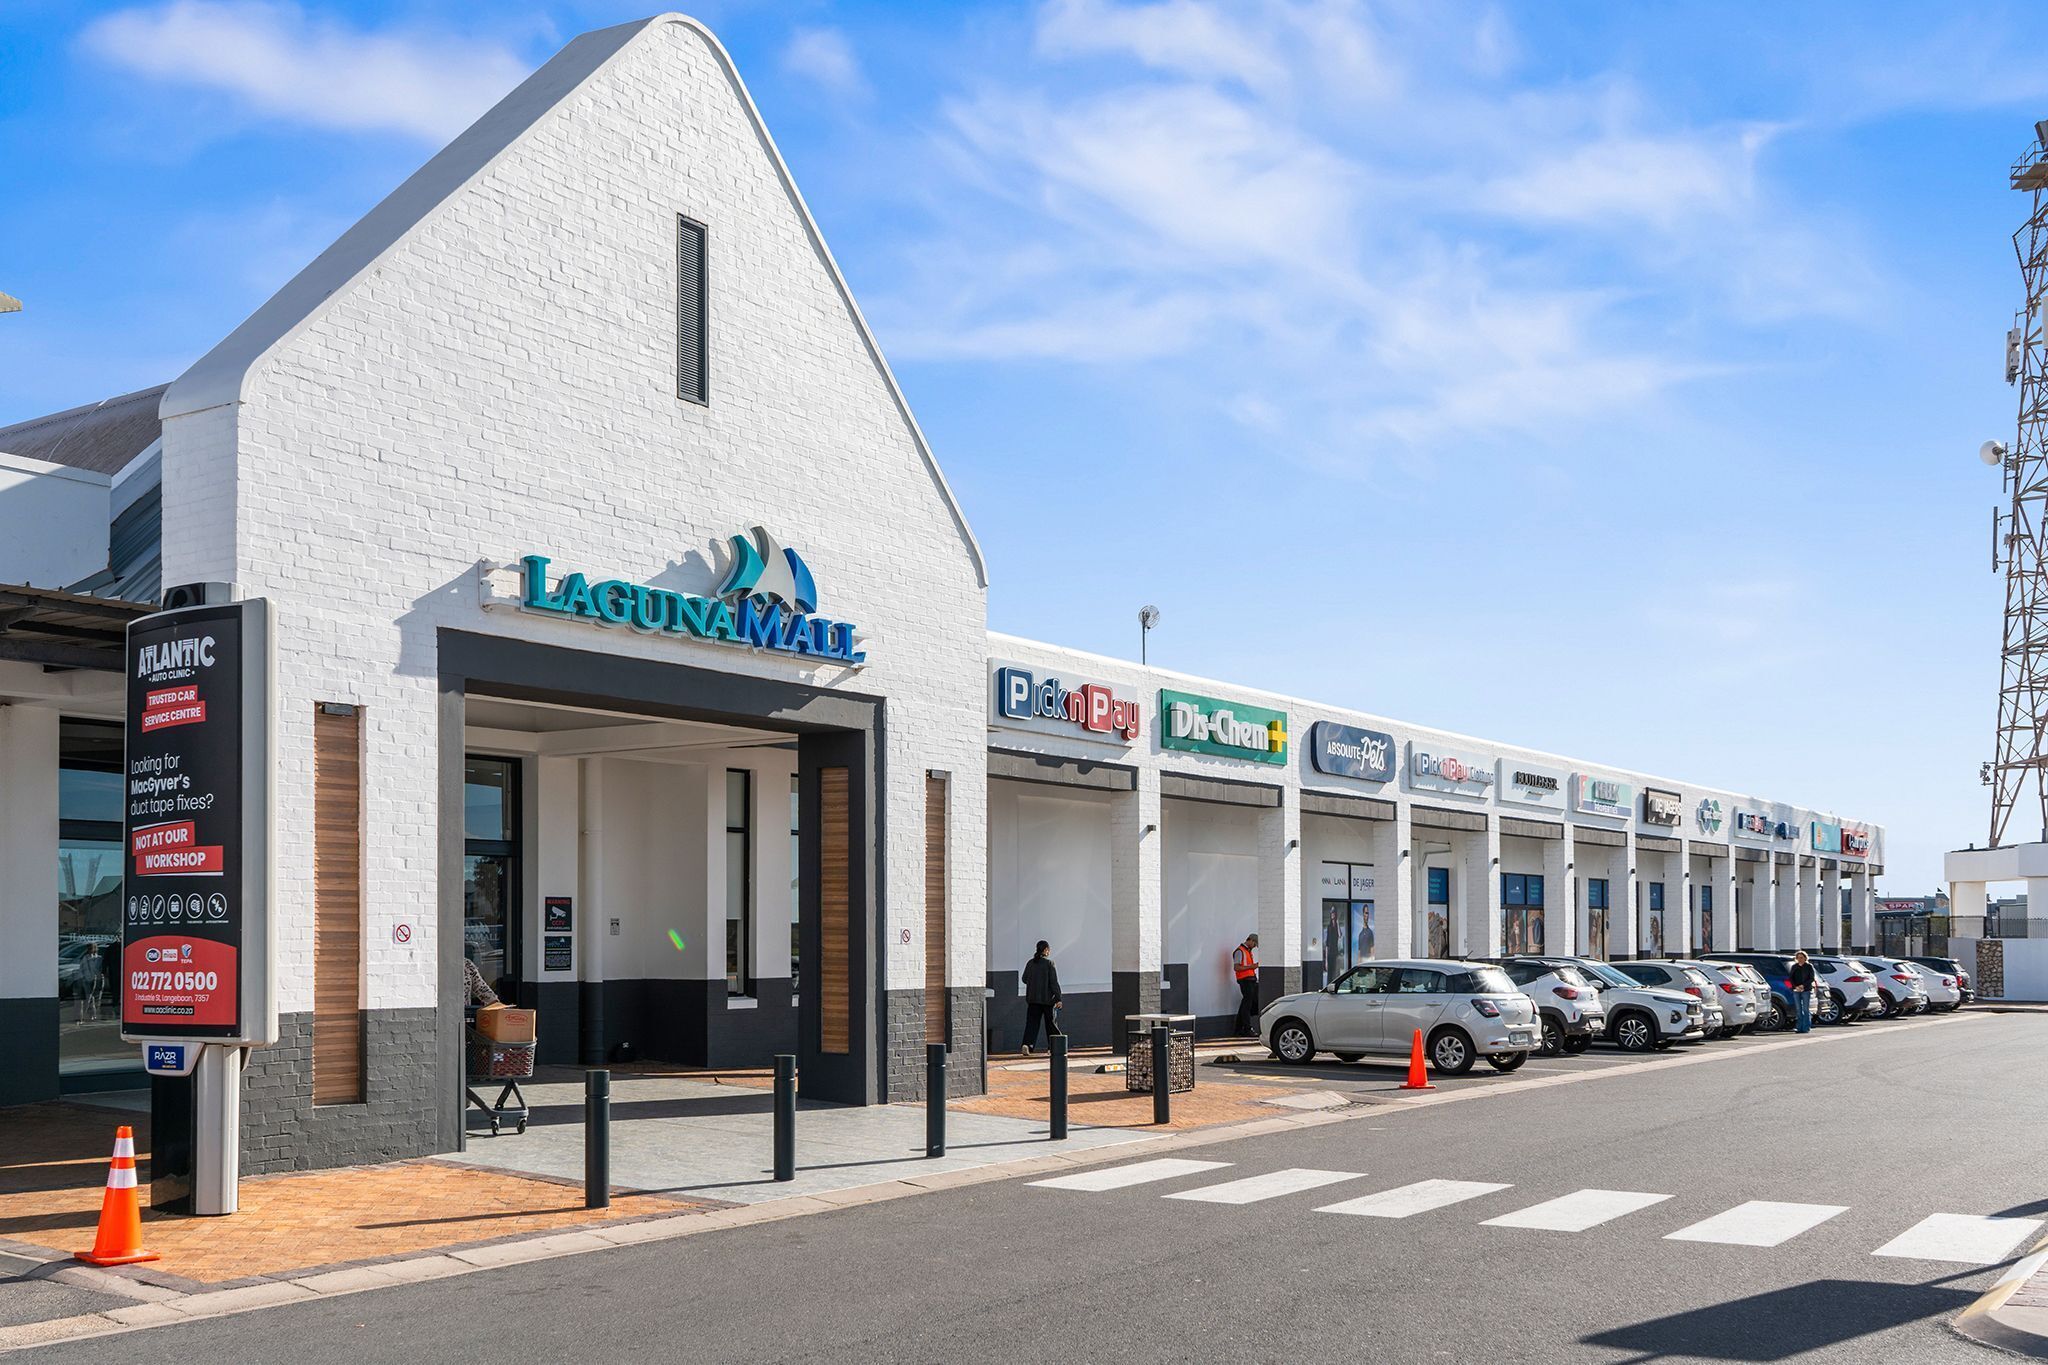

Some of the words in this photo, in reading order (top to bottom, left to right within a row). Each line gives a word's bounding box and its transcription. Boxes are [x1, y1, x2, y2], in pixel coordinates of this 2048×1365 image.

[138, 636, 216, 678] ATLANTIC
[152, 671, 167, 682] AUTO
[168, 668, 191, 680] CLINIC
[149, 692, 176, 706] TRUSTED
[177, 690, 195, 701] CAR
[1003, 666, 1068, 720] Pick
[1069, 691, 1085, 723] n
[1088, 683, 1139, 740] Pay
[144, 712, 170, 727] SERVICE
[170, 707, 201, 721] CENTRE
[1170, 701, 1268, 751] Dis-Chem
[131, 756, 162, 776] Looking
[164, 753, 180, 769] for
[1327, 741, 1361, 760] ABSOLUTE
[1360, 736, 1387, 771] Pets
[1420, 752, 1442, 775] Pick
[1449, 758, 1467, 782] Pay
[131, 773, 190, 797] MacGyver's
[130, 798, 149, 815] duct
[150, 797, 174, 817] tape
[177, 793, 214, 811] fixes?
[135, 834, 152, 850] NOT
[152, 832, 164, 846] AT
[165, 828, 188, 844] OUR
[145, 852, 206, 869] WORKSHOP
[1353, 878, 1359, 887] DE
[131, 971, 149, 990] 022
[150, 971, 172, 990] 772
[174, 971, 217, 990] 0500
[194, 994, 210, 1002] 7357
